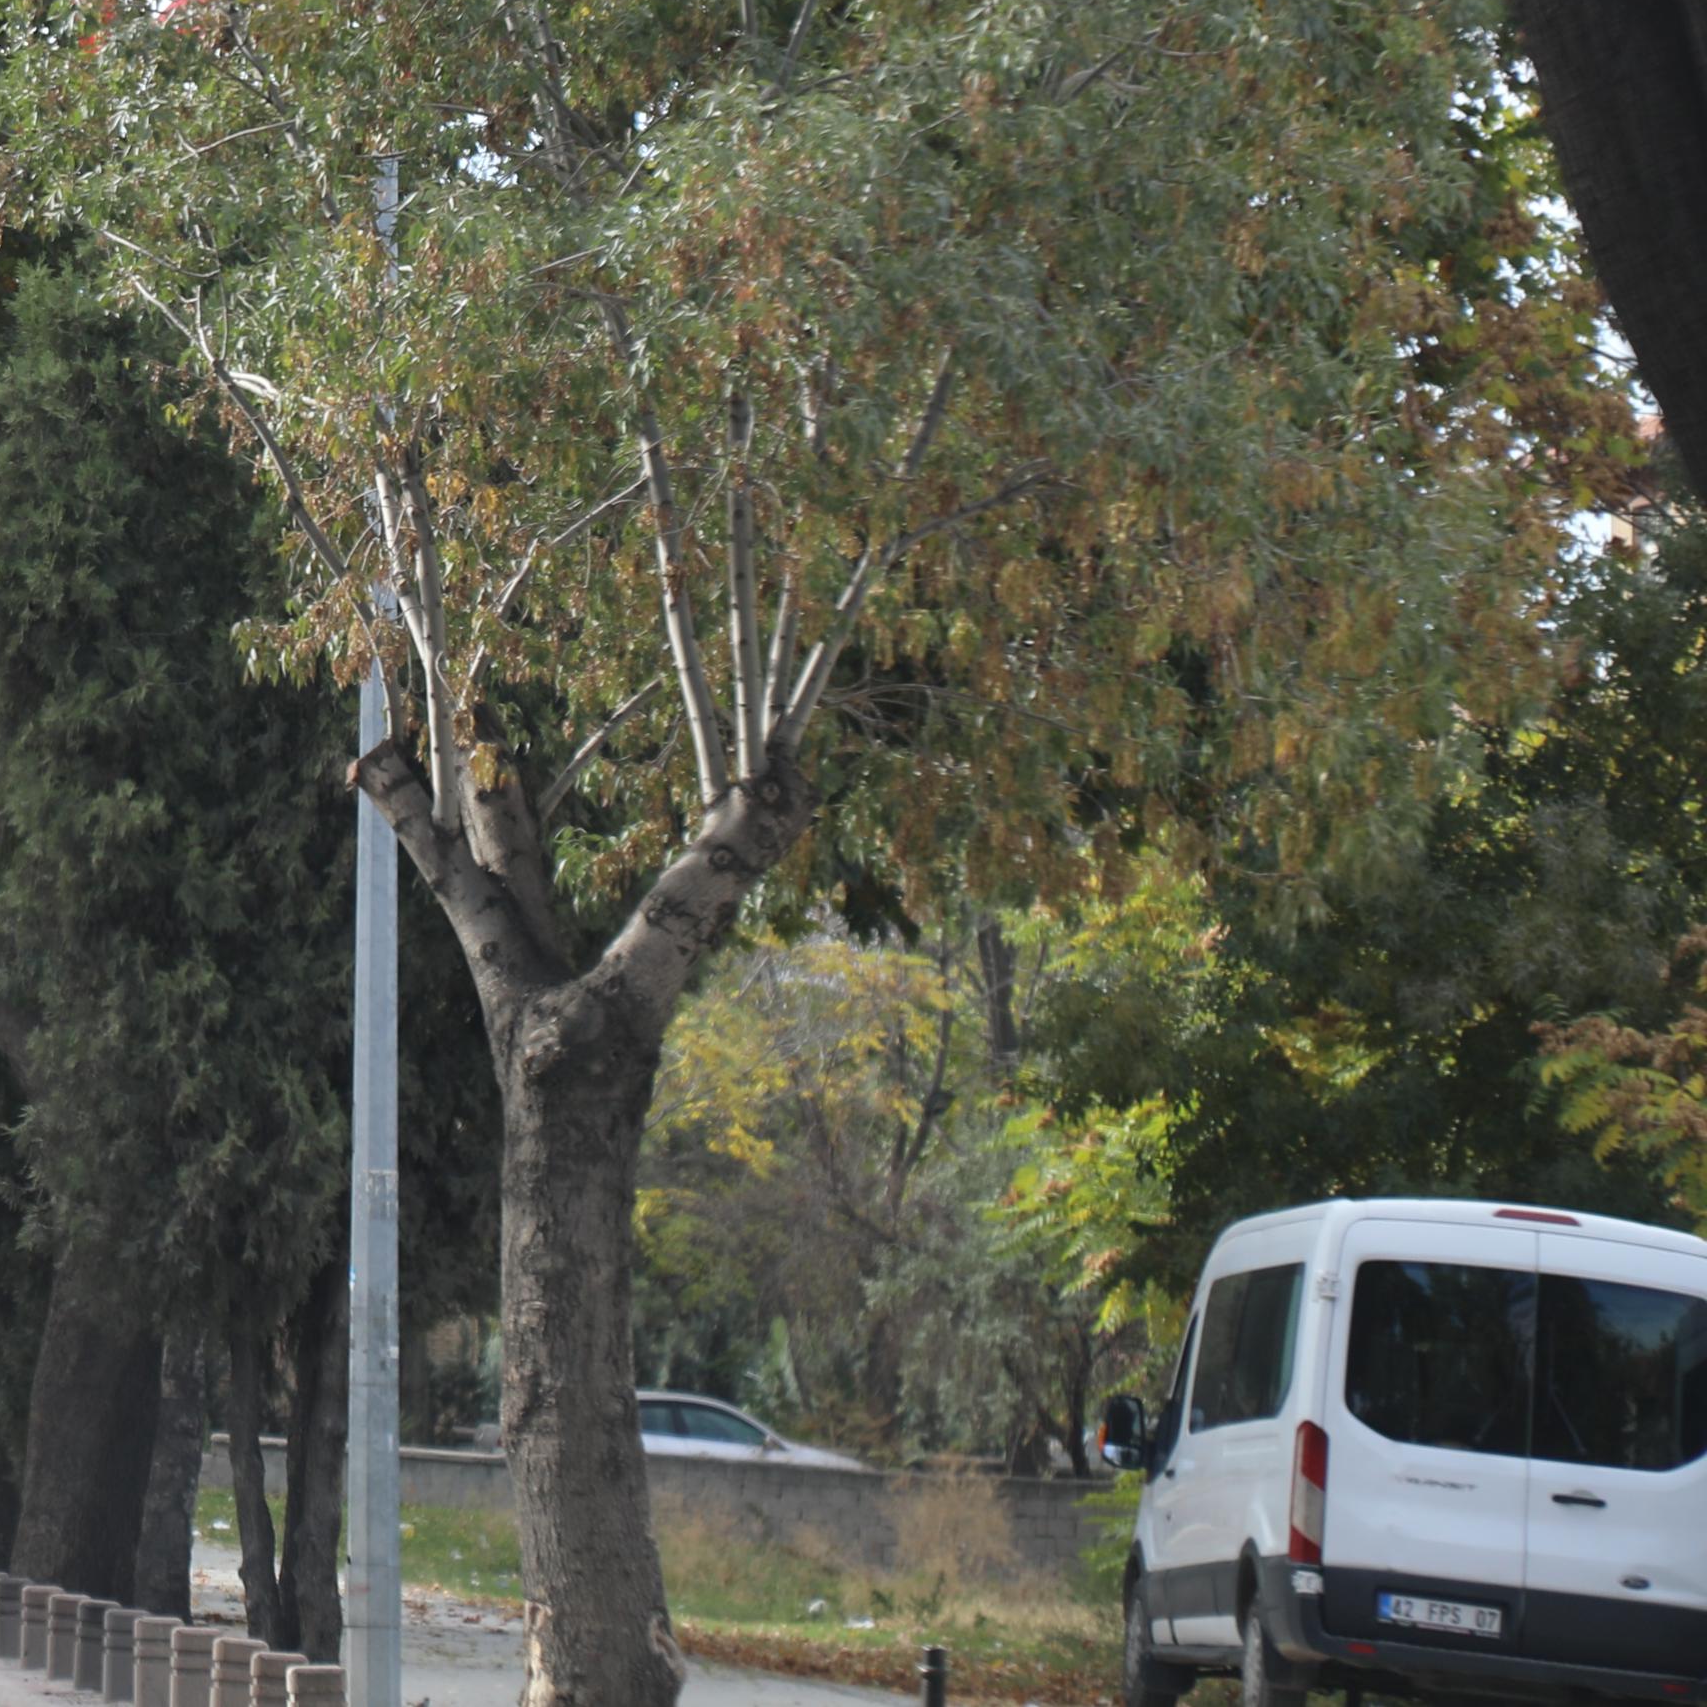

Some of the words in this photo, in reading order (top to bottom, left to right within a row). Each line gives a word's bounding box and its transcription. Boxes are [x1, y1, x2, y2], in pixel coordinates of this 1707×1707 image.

[1393, 1598, 1413, 1618] 42
[1428, 1601, 1461, 1625] FPS
[1476, 1609, 1498, 1629] 07
